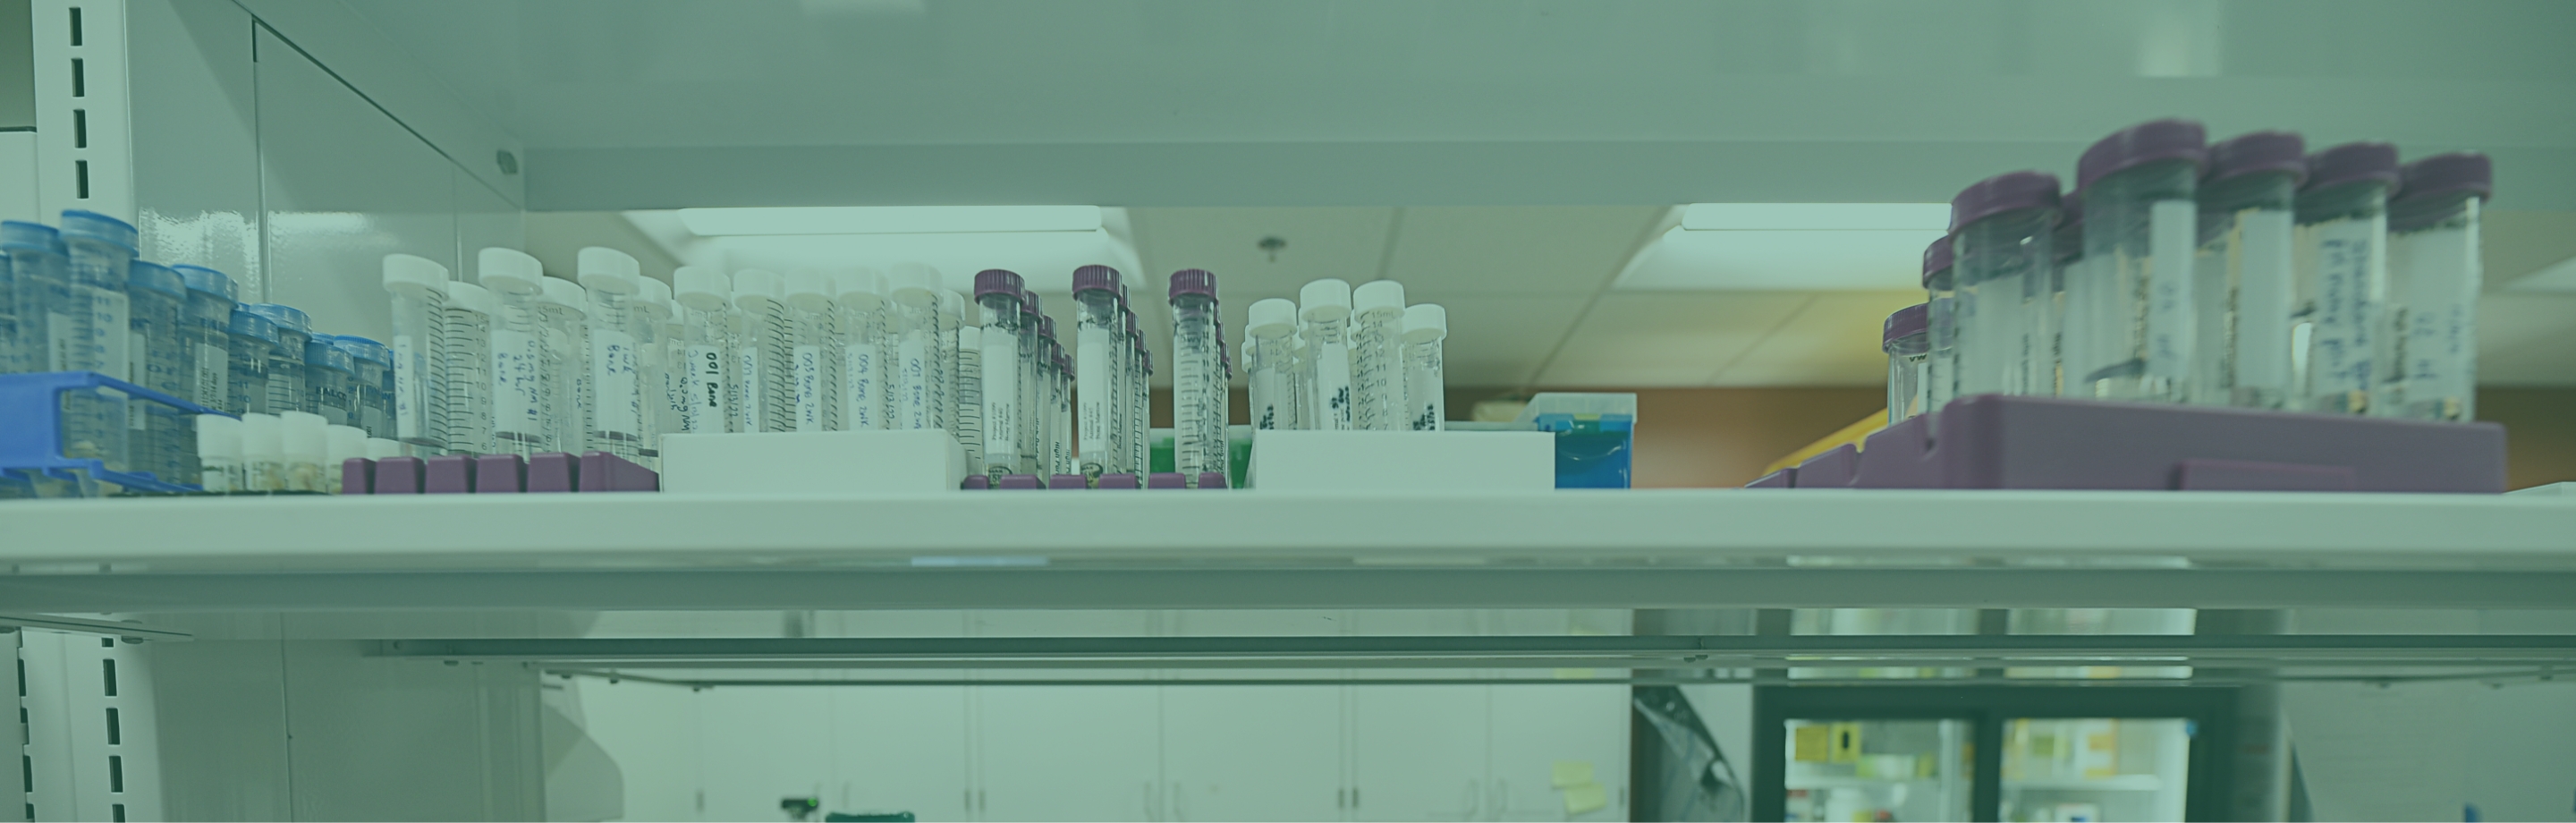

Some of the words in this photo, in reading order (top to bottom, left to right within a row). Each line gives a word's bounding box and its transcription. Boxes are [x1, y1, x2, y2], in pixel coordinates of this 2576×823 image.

[1371, 311, 1394, 319] 15mL
[1371, 320, 1383, 328] 14
[475, 337, 487, 348] 13
[476, 352, 487, 363] 12
[1375, 349, 1385, 358] 12
[1909, 353, 1928, 362] VW
[606, 344, 621, 377] Bone
[705, 351, 720, 376] 001
[857, 353, 869, 375] 004
[476, 367, 487, 377] 11
[1376, 363, 1386, 373] 11
[475, 381, 487, 392] 10
[1376, 378, 1387, 387] 10
[706, 381, 719, 408] Bone
[480, 396, 487, 406] 9
[480, 411, 487, 420] 8
[1382, 408, 1388, 417] 8
[480, 426, 487, 436] 7
[480, 441, 487, 451] 6
[1053, 441, 1061, 459] High
